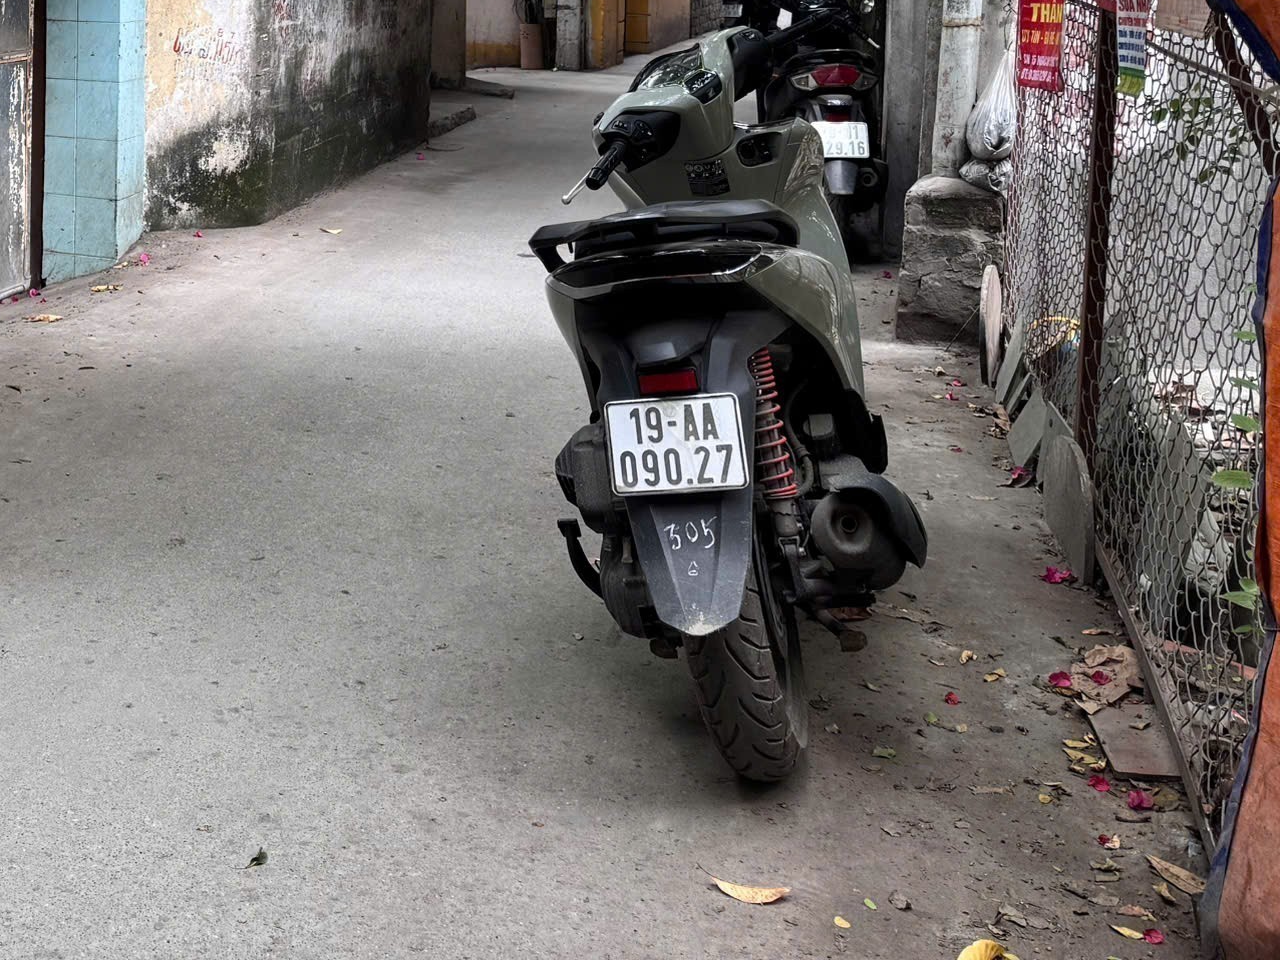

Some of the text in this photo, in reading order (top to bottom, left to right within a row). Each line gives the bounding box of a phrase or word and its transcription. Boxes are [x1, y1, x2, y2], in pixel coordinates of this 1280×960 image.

[630, 402, 719, 444] 19-AA
[620, 444, 733, 488] 090.27
[663, 515, 719, 550] 305
